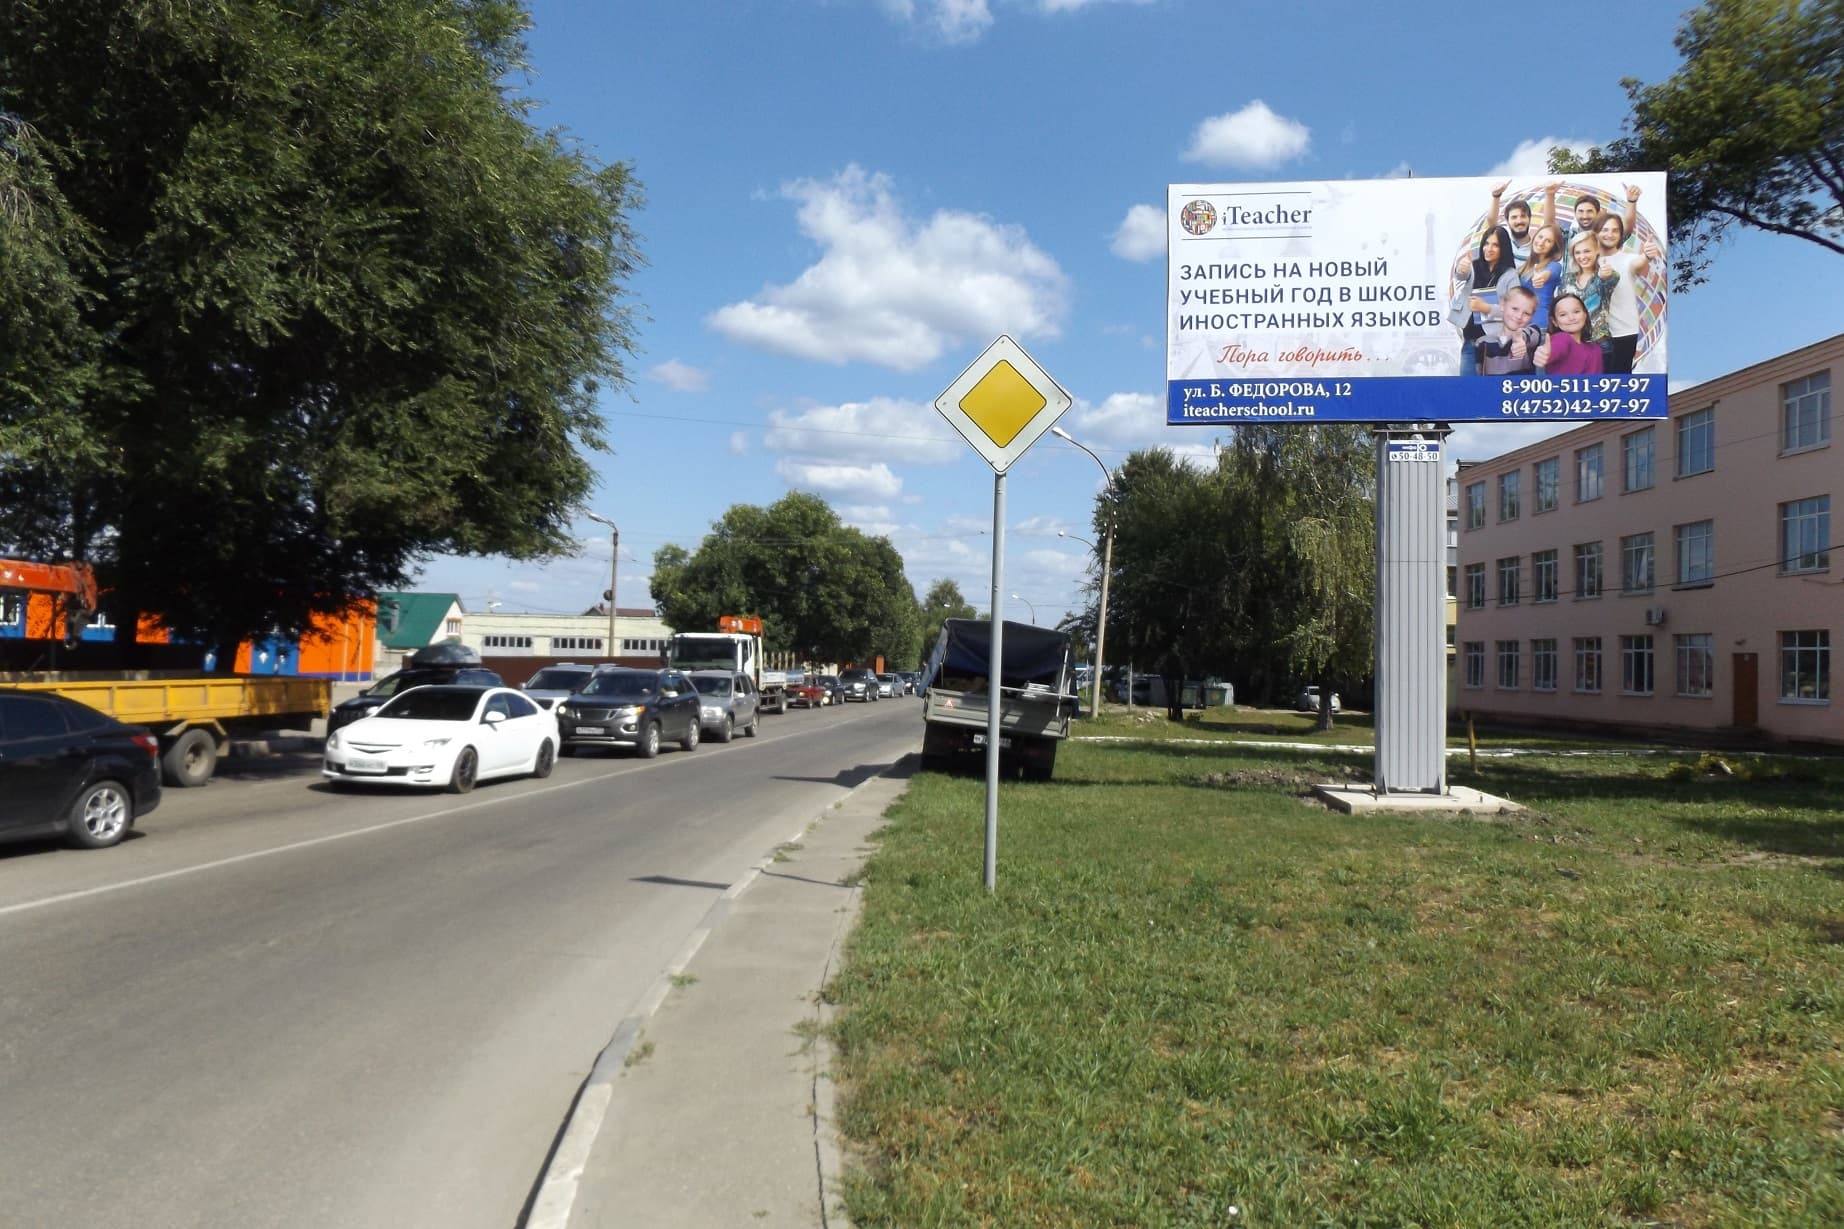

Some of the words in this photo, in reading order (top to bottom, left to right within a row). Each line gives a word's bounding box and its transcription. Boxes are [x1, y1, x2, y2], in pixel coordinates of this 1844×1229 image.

[1222, 204, 1312, 226] iTeacher
[1180, 263, 1266, 280] ЗАПИСЬ
[1273, 262, 1303, 278] НА
[1309, 257, 1388, 278] НОВЫЙ
[1180, 284, 1284, 305] УЧЕБНЫЙ
[1291, 287, 1333, 306] ГОД
[1339, 286, 1352, 302] В
[1358, 285, 1436, 302] ШКОЛЕ
[1180, 312, 1344, 330] ИНОСТРАННЫХ
[1350, 310, 1441, 327] ЯЗЫКОВ
[1216, 344, 1269, 369] Пора
[1183, 387, 1206, 399] ул.
[1210, 383, 1225, 398] Б.
[1228, 382, 1330, 399] ФЕДОРОВА,
[1335, 382, 1352, 397] 12
[1502, 378, 1650, 394] 8-900-511-97-97
[1183, 403, 1315, 417] iteacherschool.ru
[1501, 398, 1650, 416] 8(4752)42-97-97
